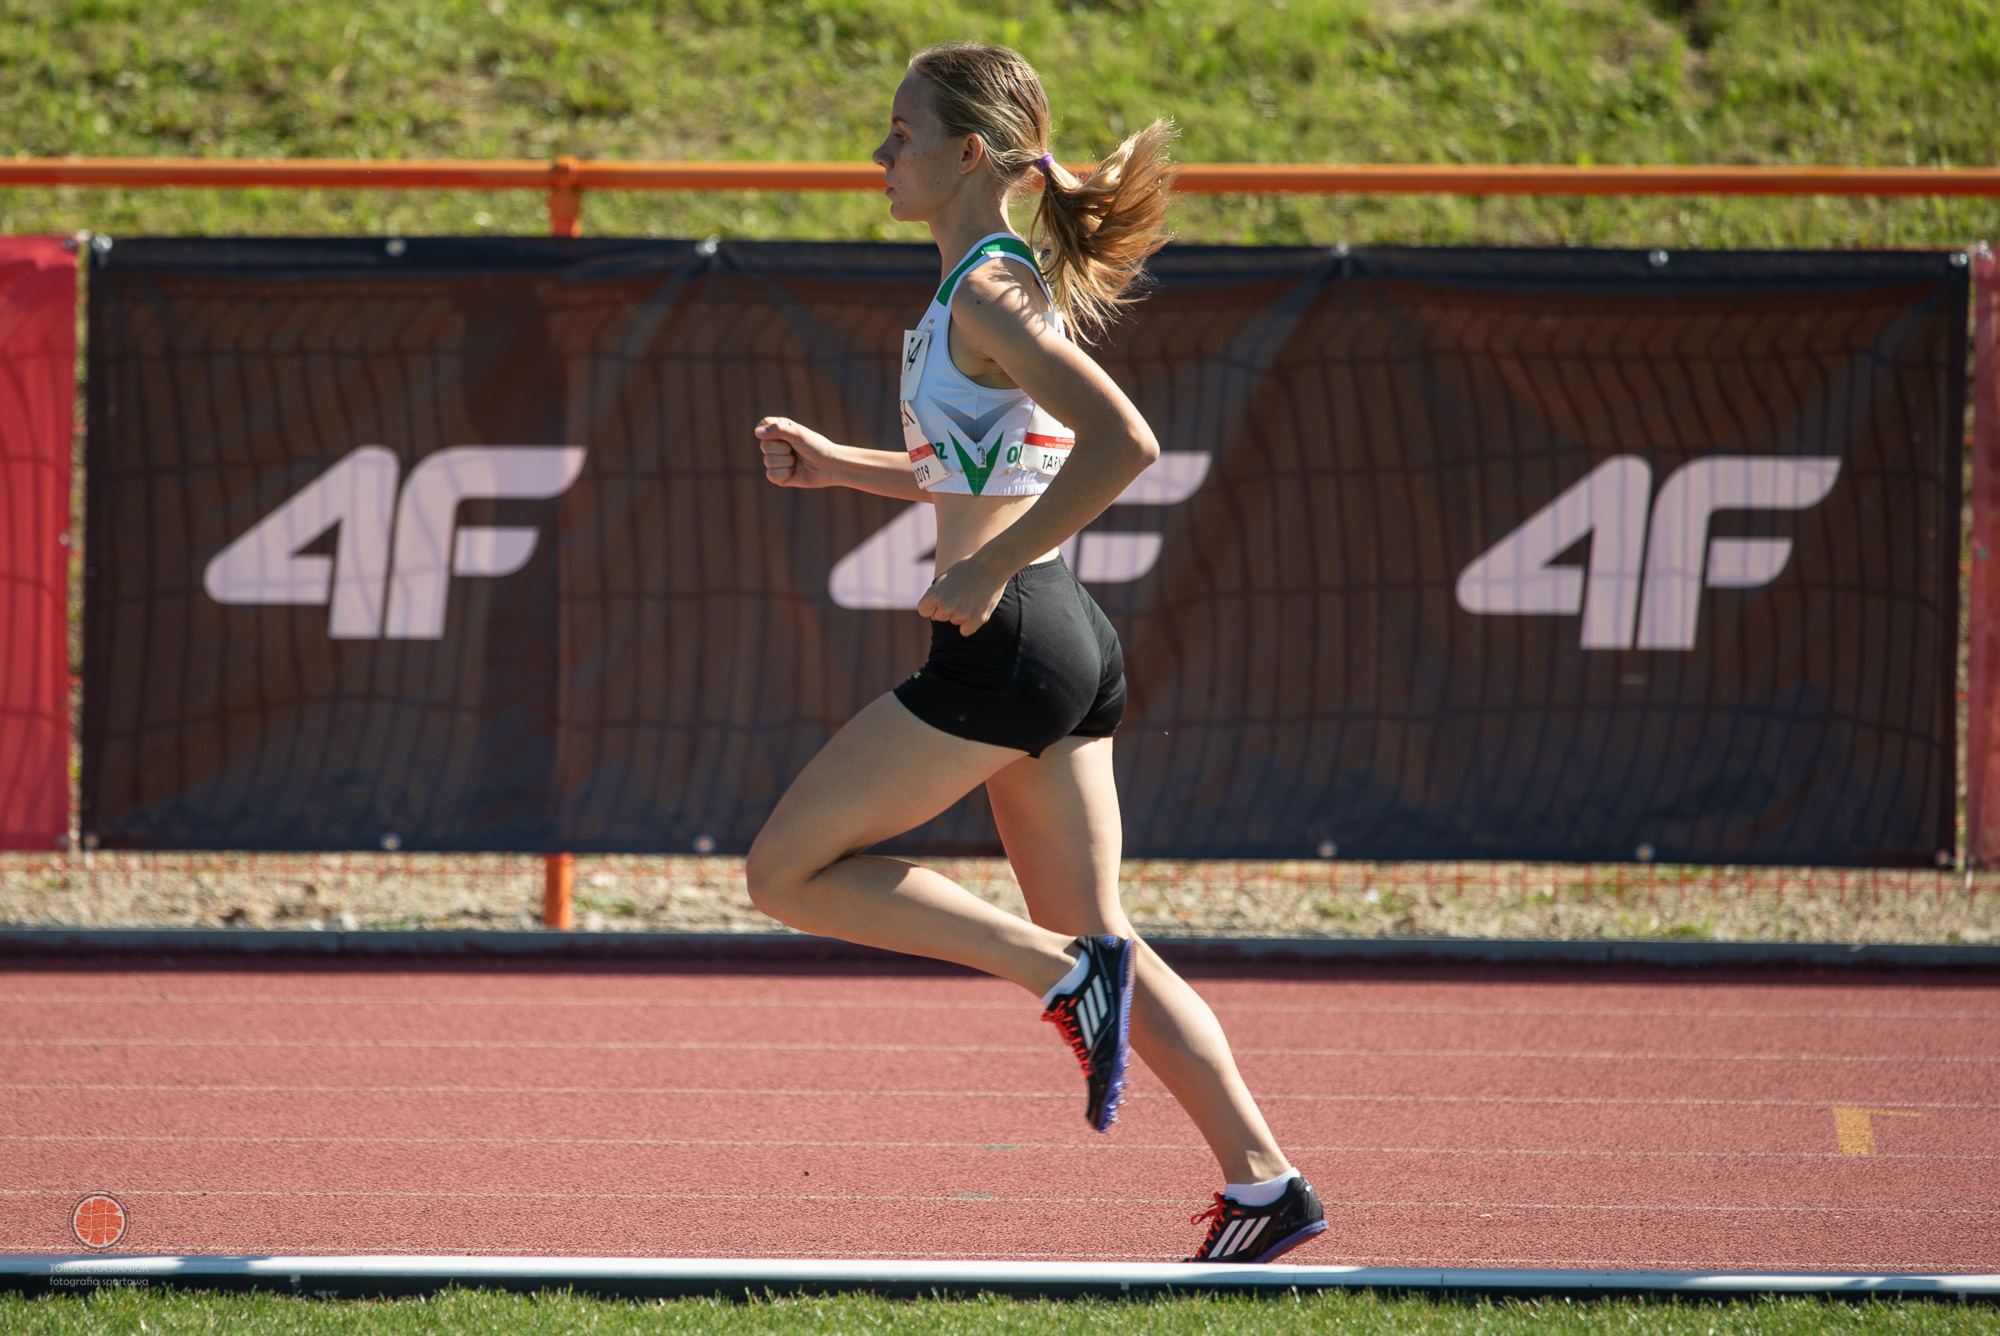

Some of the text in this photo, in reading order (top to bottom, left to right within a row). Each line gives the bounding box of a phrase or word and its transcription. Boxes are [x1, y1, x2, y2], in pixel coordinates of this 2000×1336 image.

[204, 444, 586, 639] 4F
[914, 464, 931, 483] 019
[1456, 454, 1841, 650] 4F
